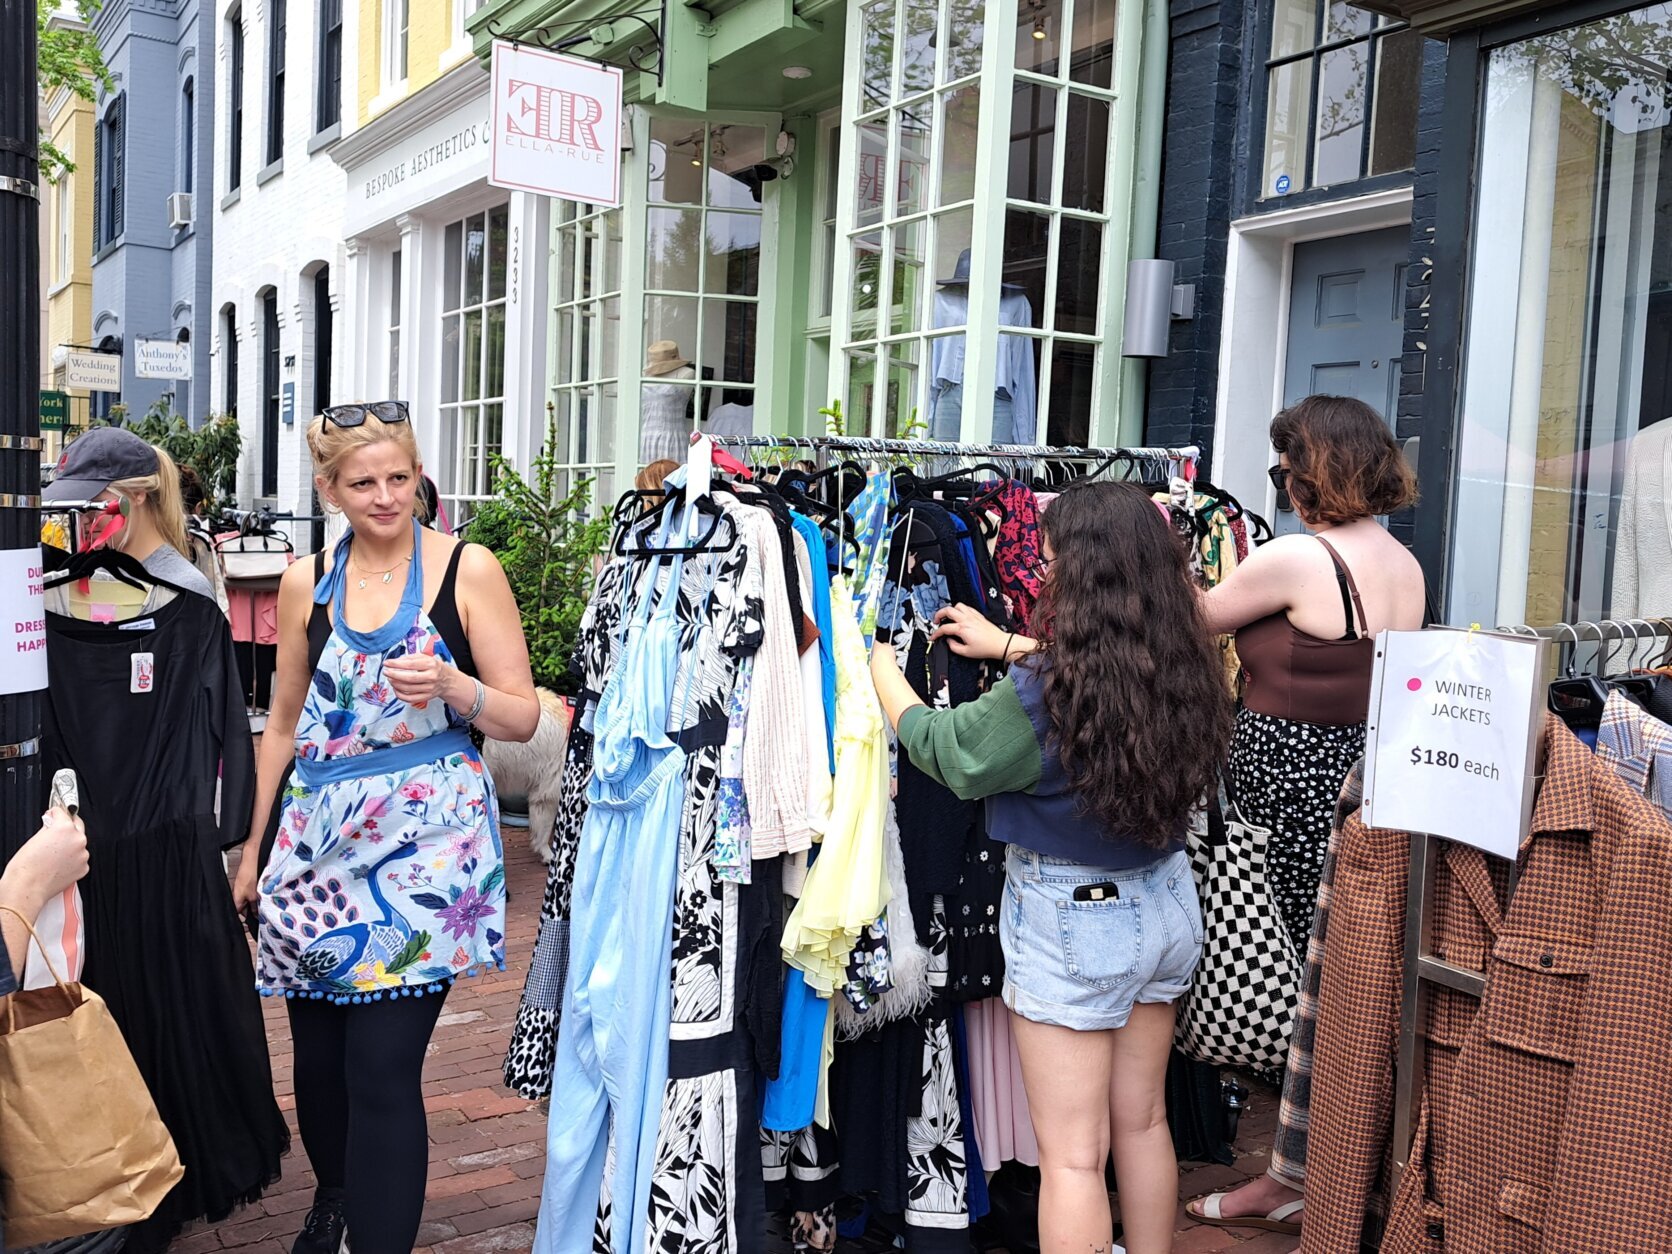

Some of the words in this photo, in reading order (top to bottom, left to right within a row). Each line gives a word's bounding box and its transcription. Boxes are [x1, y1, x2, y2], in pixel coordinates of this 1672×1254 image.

[505, 135, 605, 164] ELLA-RUE
[366, 163, 405, 199] BESPOKE
[411, 125, 477, 176] AESTHETICS
[71, 358, 116, 373] Wedding
[138, 348, 187, 362] Anthony's
[141, 362, 183, 373] Tuxedos
[70, 373, 117, 385] Creations
[1435, 680, 1492, 702] WINTER
[1431, 703, 1491, 726] JACKETS
[1410, 745, 1459, 769] $180
[1464, 759, 1499, 781] each
